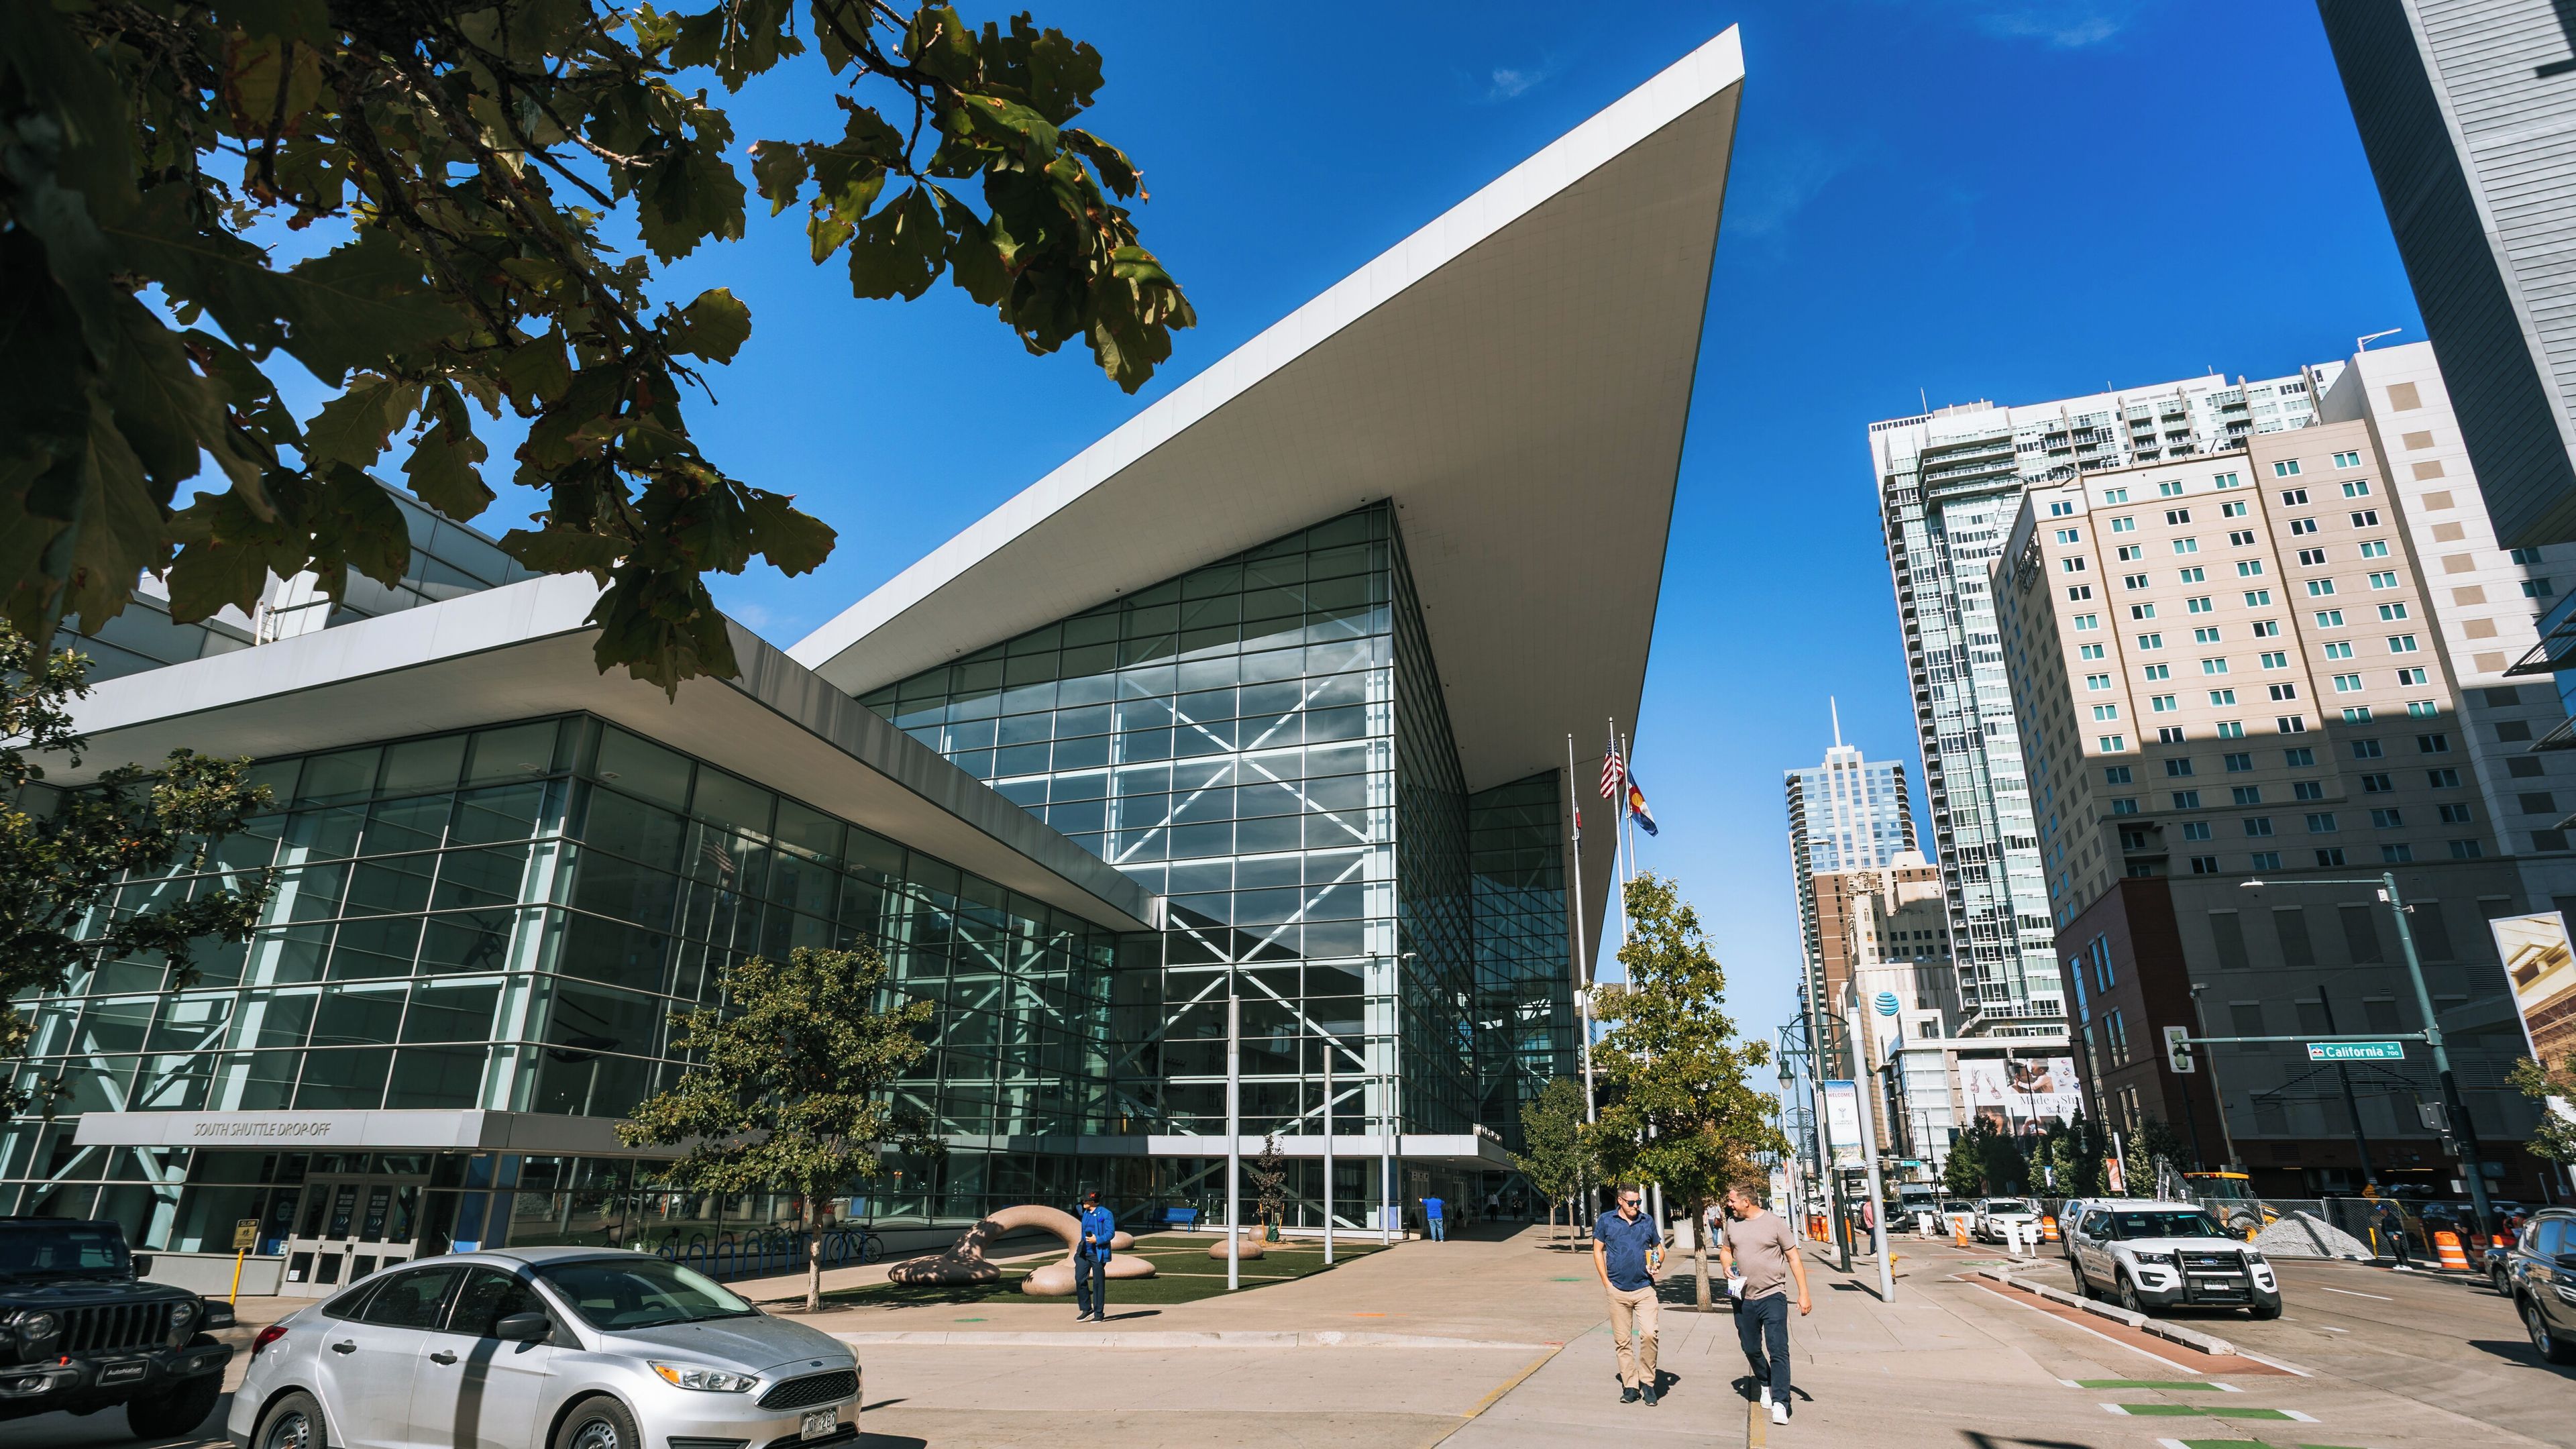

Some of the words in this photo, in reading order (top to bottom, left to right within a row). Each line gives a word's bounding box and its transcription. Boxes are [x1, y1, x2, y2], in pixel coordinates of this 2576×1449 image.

[2326, 1046, 2384, 1057] California
[194, 1123, 229, 1136] SOUTH
[230, 1123, 276, 1136] SHUTTLE
[276, 1122, 331, 1136] DROP-OFF
[107, 1367, 142, 1376] AutoNation
